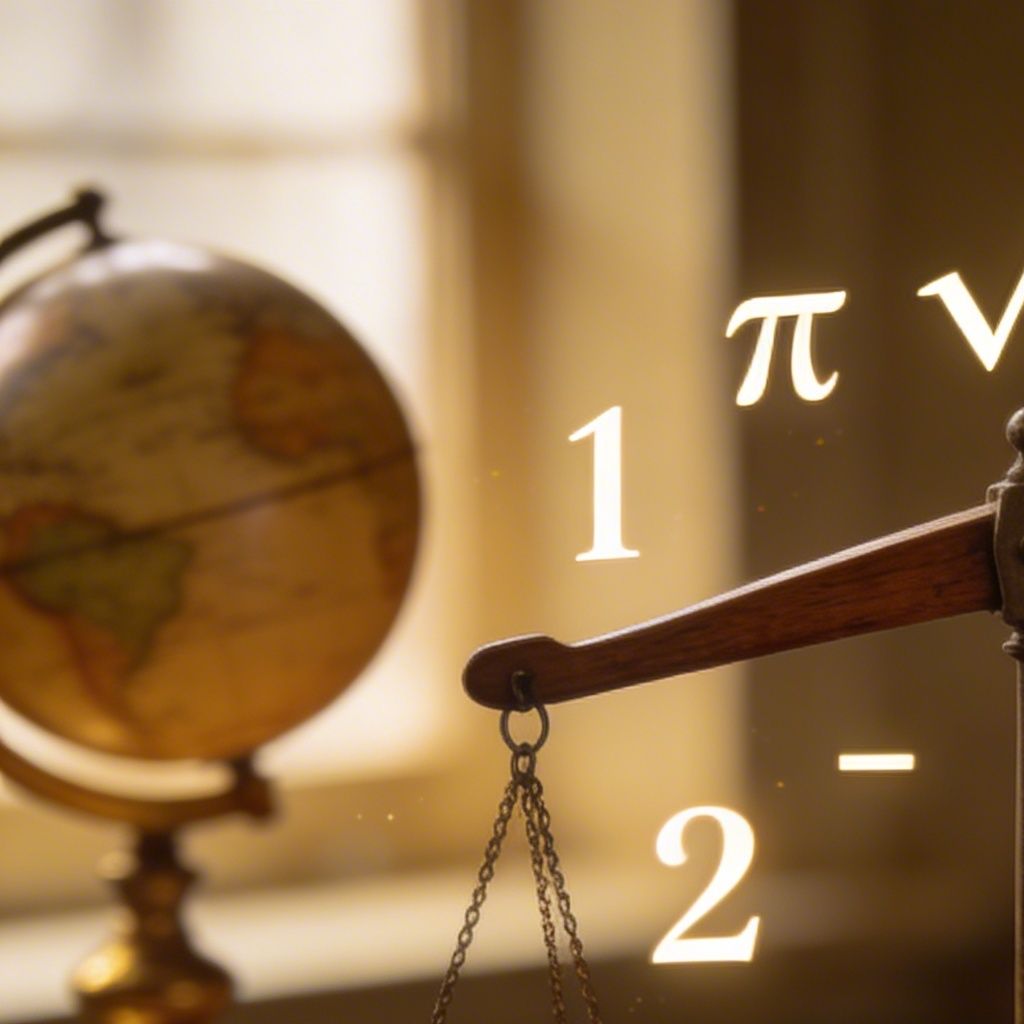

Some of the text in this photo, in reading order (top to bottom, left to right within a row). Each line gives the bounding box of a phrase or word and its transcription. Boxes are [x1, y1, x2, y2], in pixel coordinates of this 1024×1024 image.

[725, 290, 847, 406] π
[568, 405, 641, 562] 1
[652, 805, 760, 965] 2
